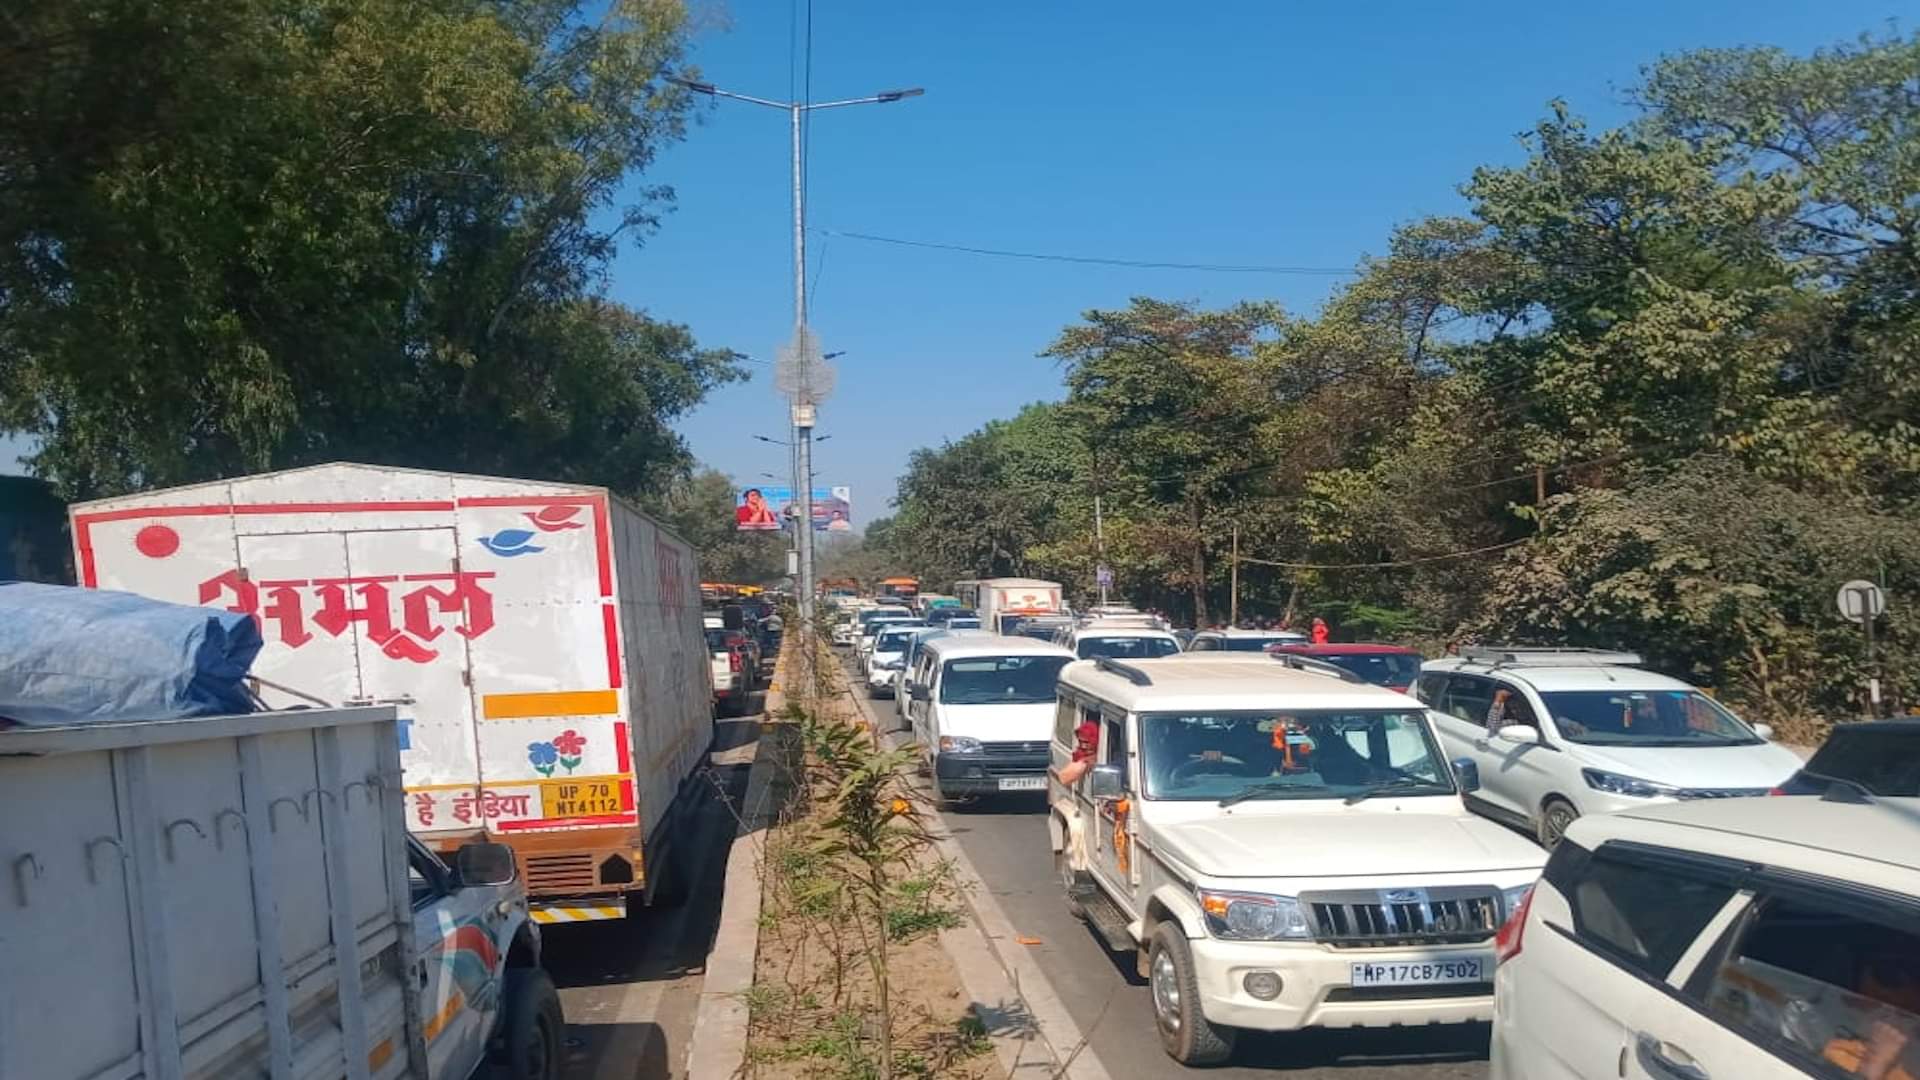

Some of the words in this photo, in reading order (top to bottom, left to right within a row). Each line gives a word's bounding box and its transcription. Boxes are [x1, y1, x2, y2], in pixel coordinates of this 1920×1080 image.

[559, 785, 578, 799] UP
[588, 784, 609, 798] 70
[415, 792, 436, 826] है
[452, 790, 531, 824] इंडिया
[556, 798, 618, 816] NT4112
[1364, 962, 1479, 983] MP17CB7502
